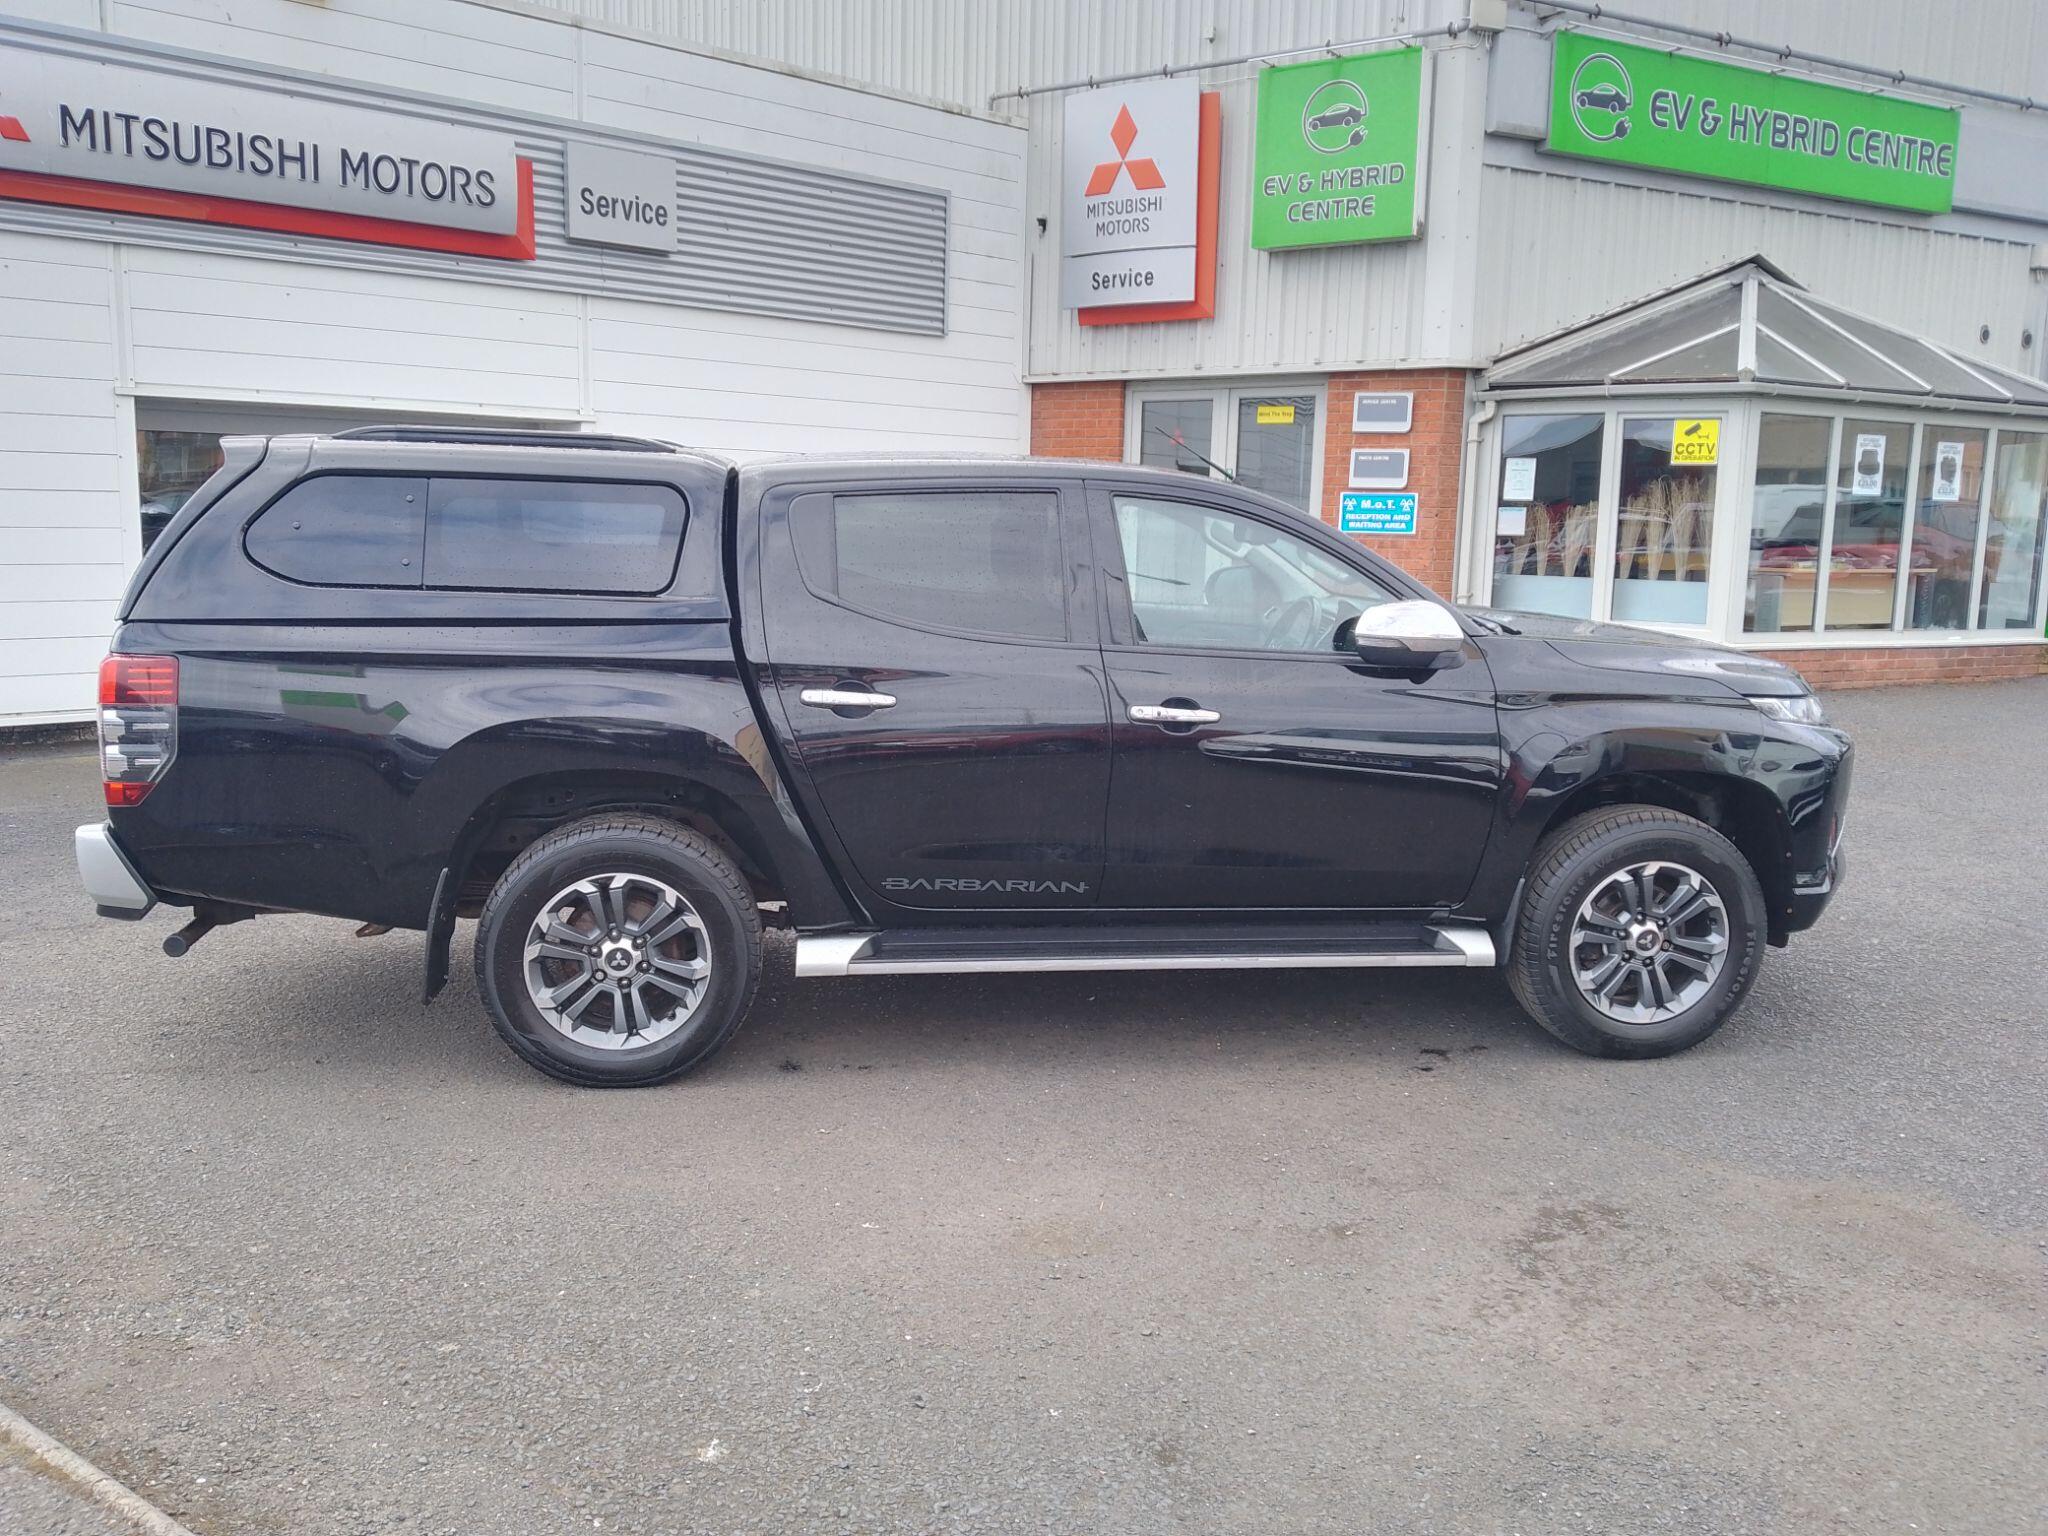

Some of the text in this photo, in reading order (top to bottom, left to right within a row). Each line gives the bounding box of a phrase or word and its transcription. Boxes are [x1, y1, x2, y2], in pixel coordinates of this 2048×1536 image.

[1650, 89, 1953, 178] EV & HYBRID CENTRE
[59, 103, 497, 209] MITSUBISHI MOTORS
[1263, 162, 1405, 197] EV & HYBRID
[579, 186, 669, 228] Service
[1086, 196, 1163, 220] MITSUBISHI
[1287, 194, 1376, 224] CENTRE
[1095, 217, 1151, 238] MOTORS
[1091, 267, 1155, 291] Service
[1675, 442, 1716, 455] CCTV
[1345, 513, 1392, 521] RECEPTION
[881, 877, 1089, 893] BARBARIAN
